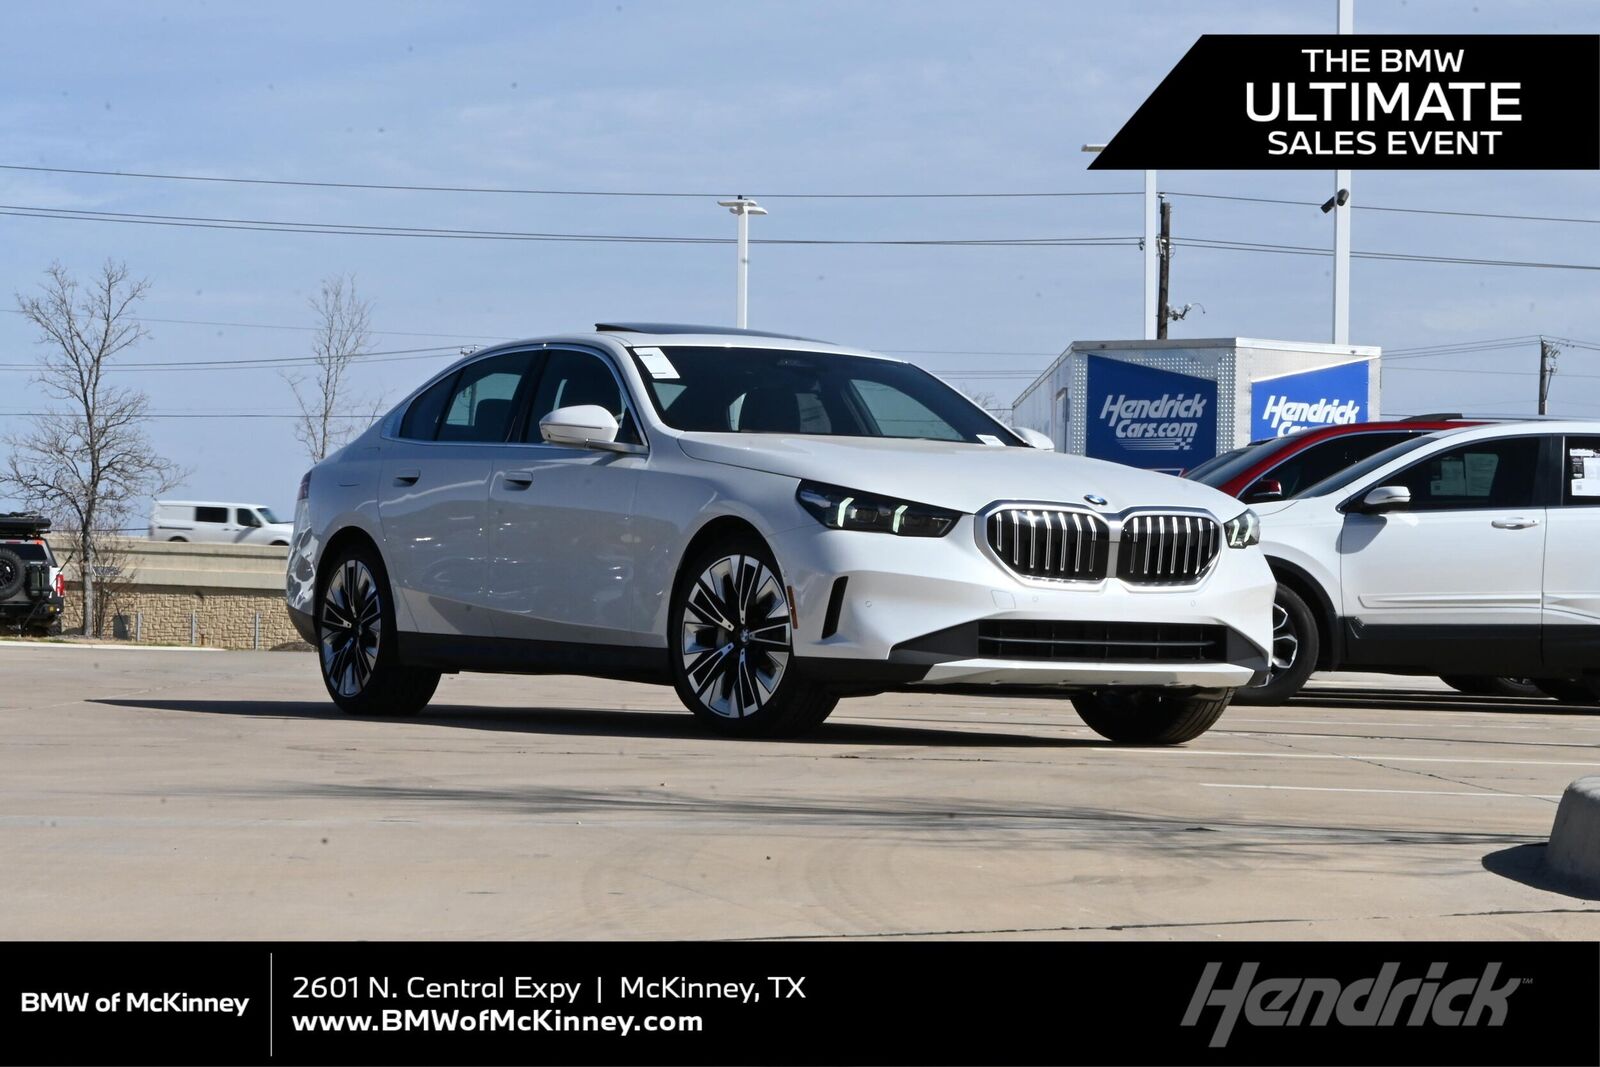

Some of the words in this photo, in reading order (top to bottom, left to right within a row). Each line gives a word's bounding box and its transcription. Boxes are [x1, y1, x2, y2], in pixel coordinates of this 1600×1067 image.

[1100, 393, 1207, 427] Hendrick
[1262, 395, 1360, 428] Hendrick
[1115, 419, 1198, 438] Cars.com
